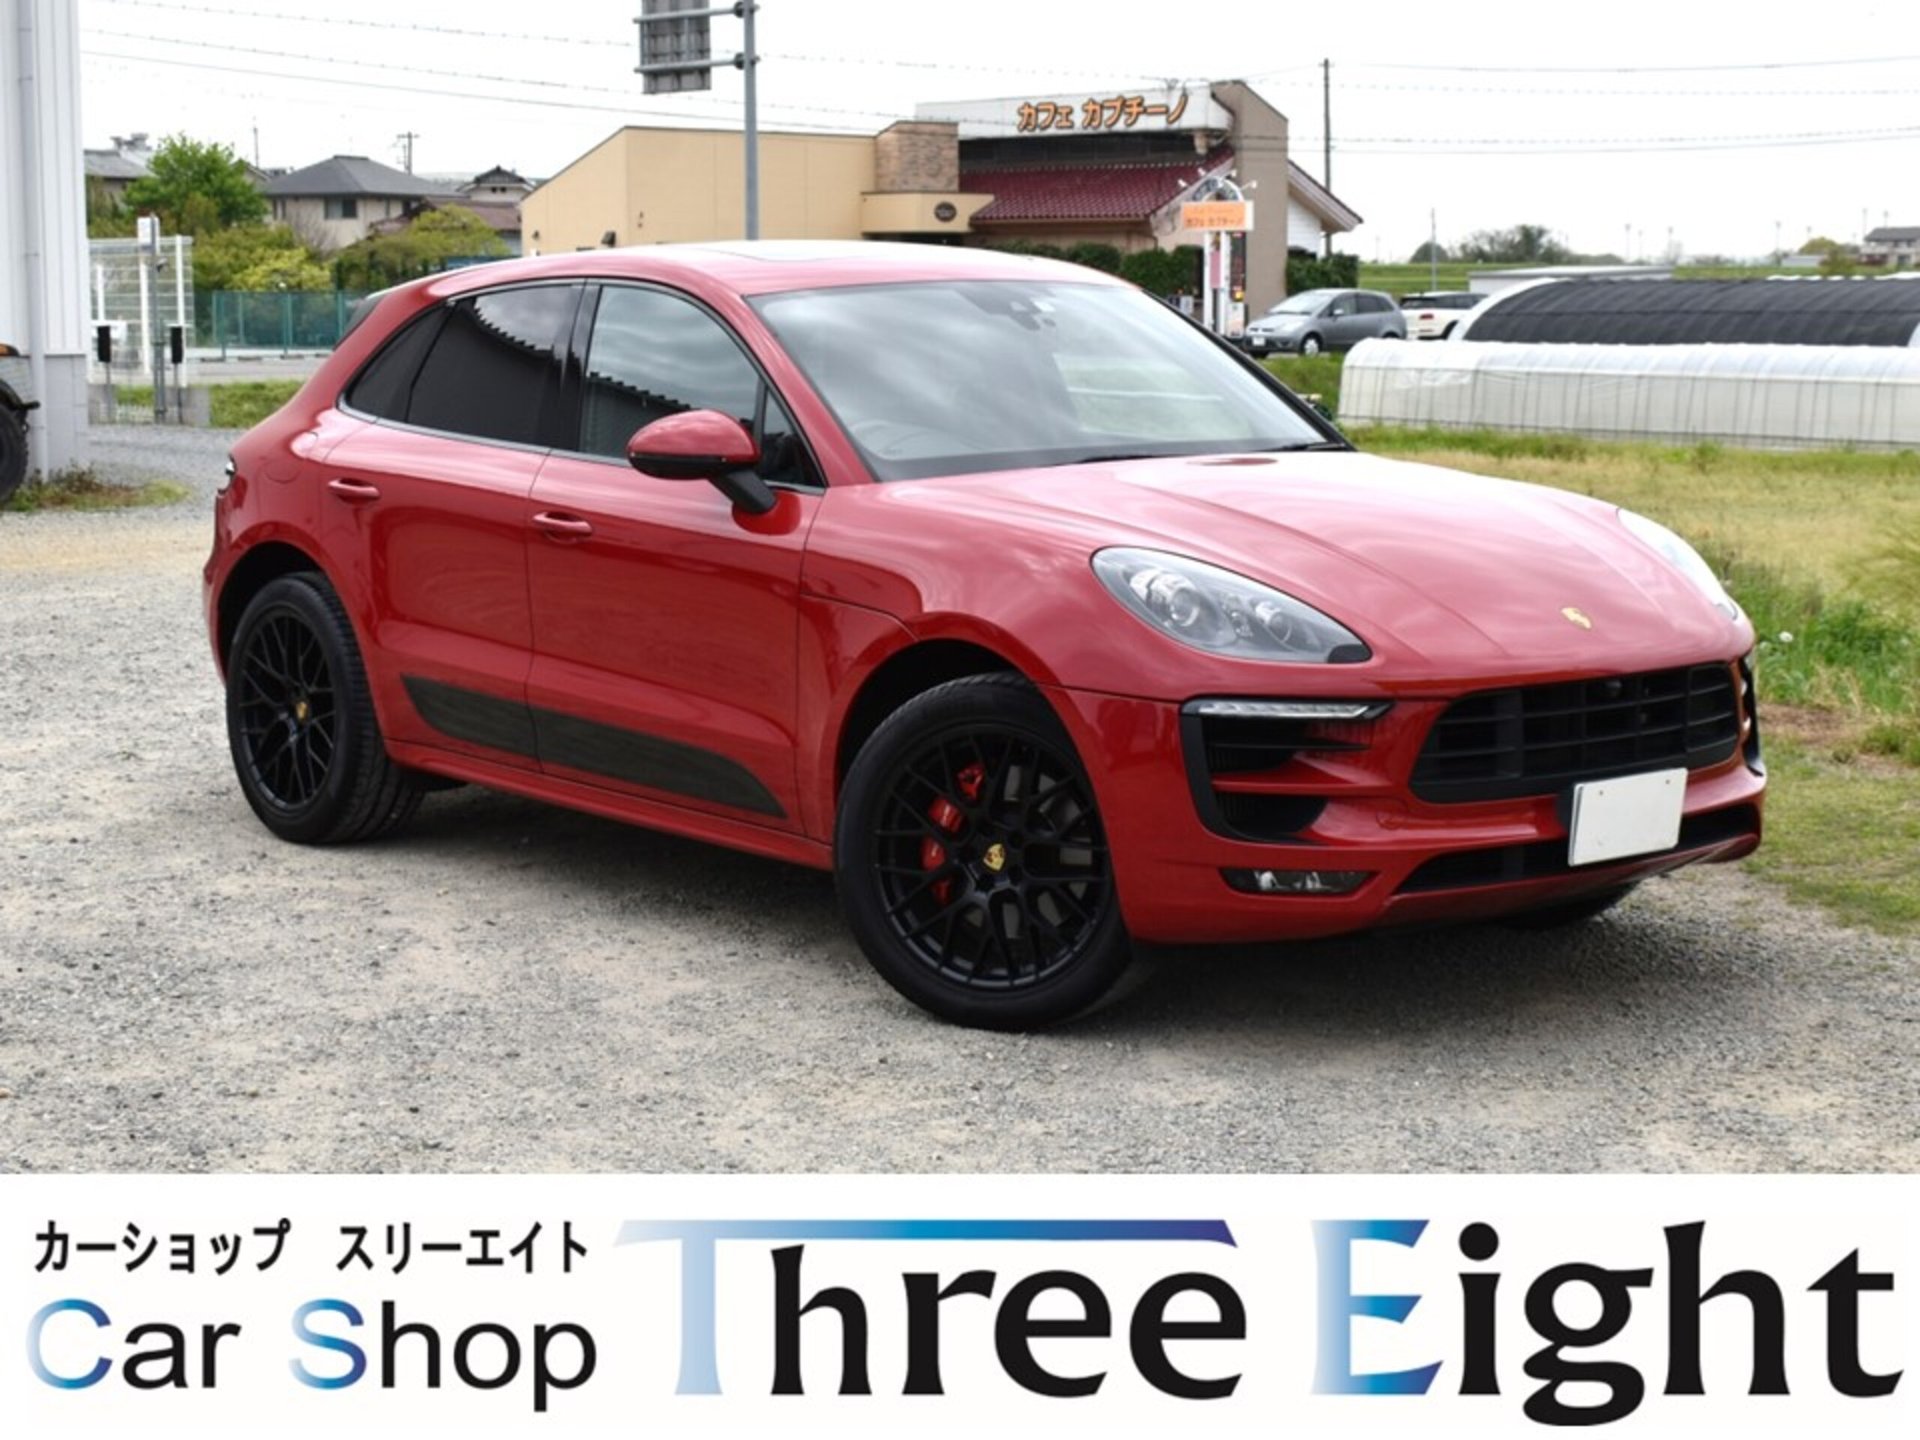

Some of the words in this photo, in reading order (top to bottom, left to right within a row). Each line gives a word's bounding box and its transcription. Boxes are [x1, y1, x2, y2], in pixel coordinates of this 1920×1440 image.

[1018, 102, 1074, 131] カフェ
[1082, 95, 1187, 127] カプチーノ
